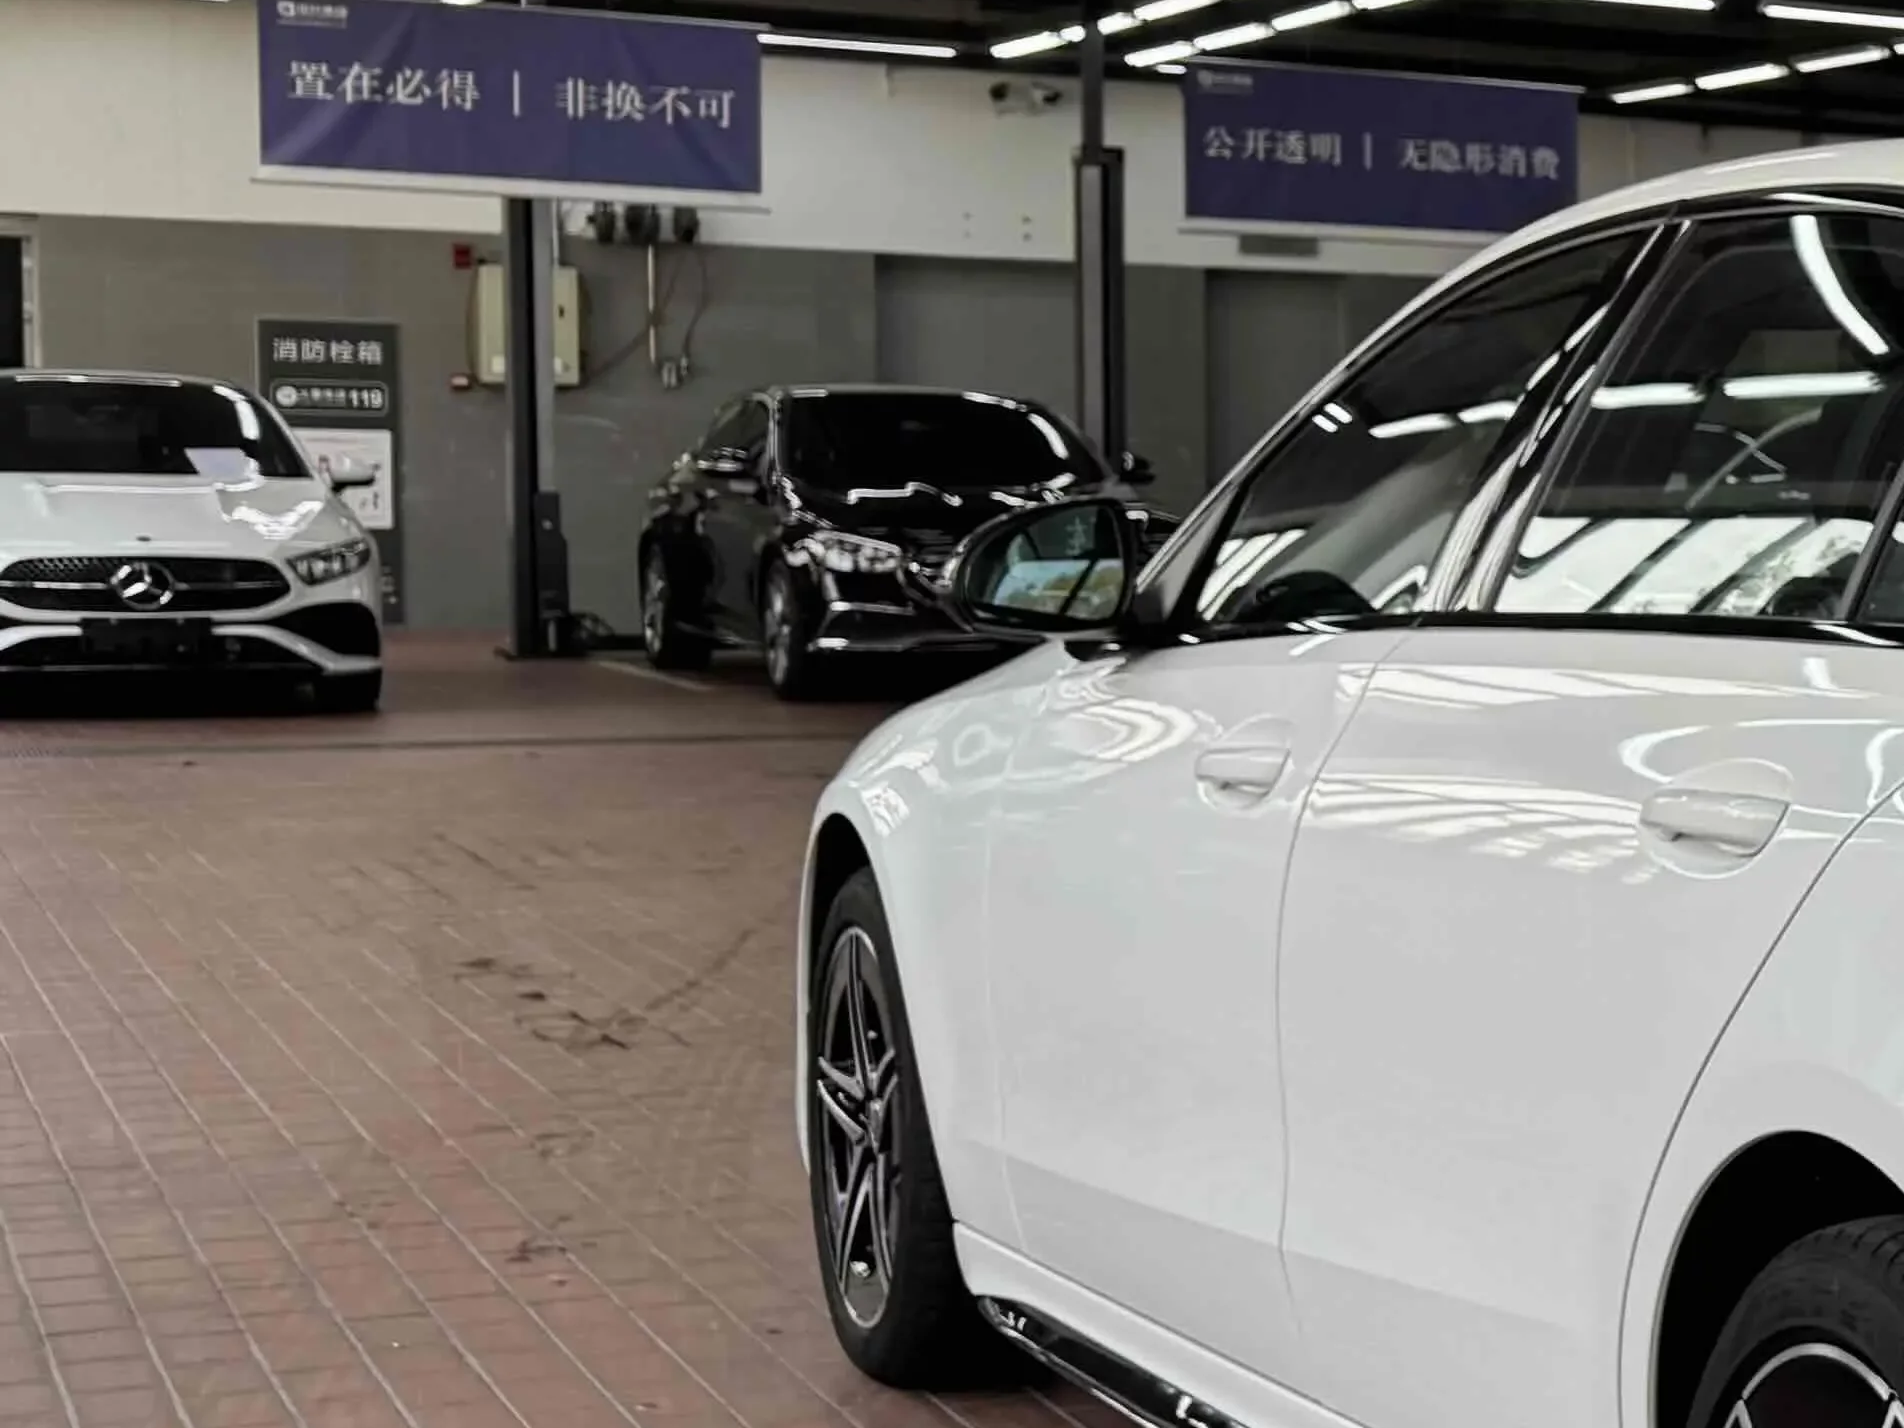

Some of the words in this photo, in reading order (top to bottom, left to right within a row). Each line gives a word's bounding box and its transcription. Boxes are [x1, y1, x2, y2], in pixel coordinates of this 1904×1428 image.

[289, 61, 480, 112] 置在必得
[555, 76, 736, 129] 非换不可
[1203, 126, 1343, 167] 公开透明
[1400, 137, 1561, 180] 无隐形消费
[272, 337, 383, 365] 消防栓箱
